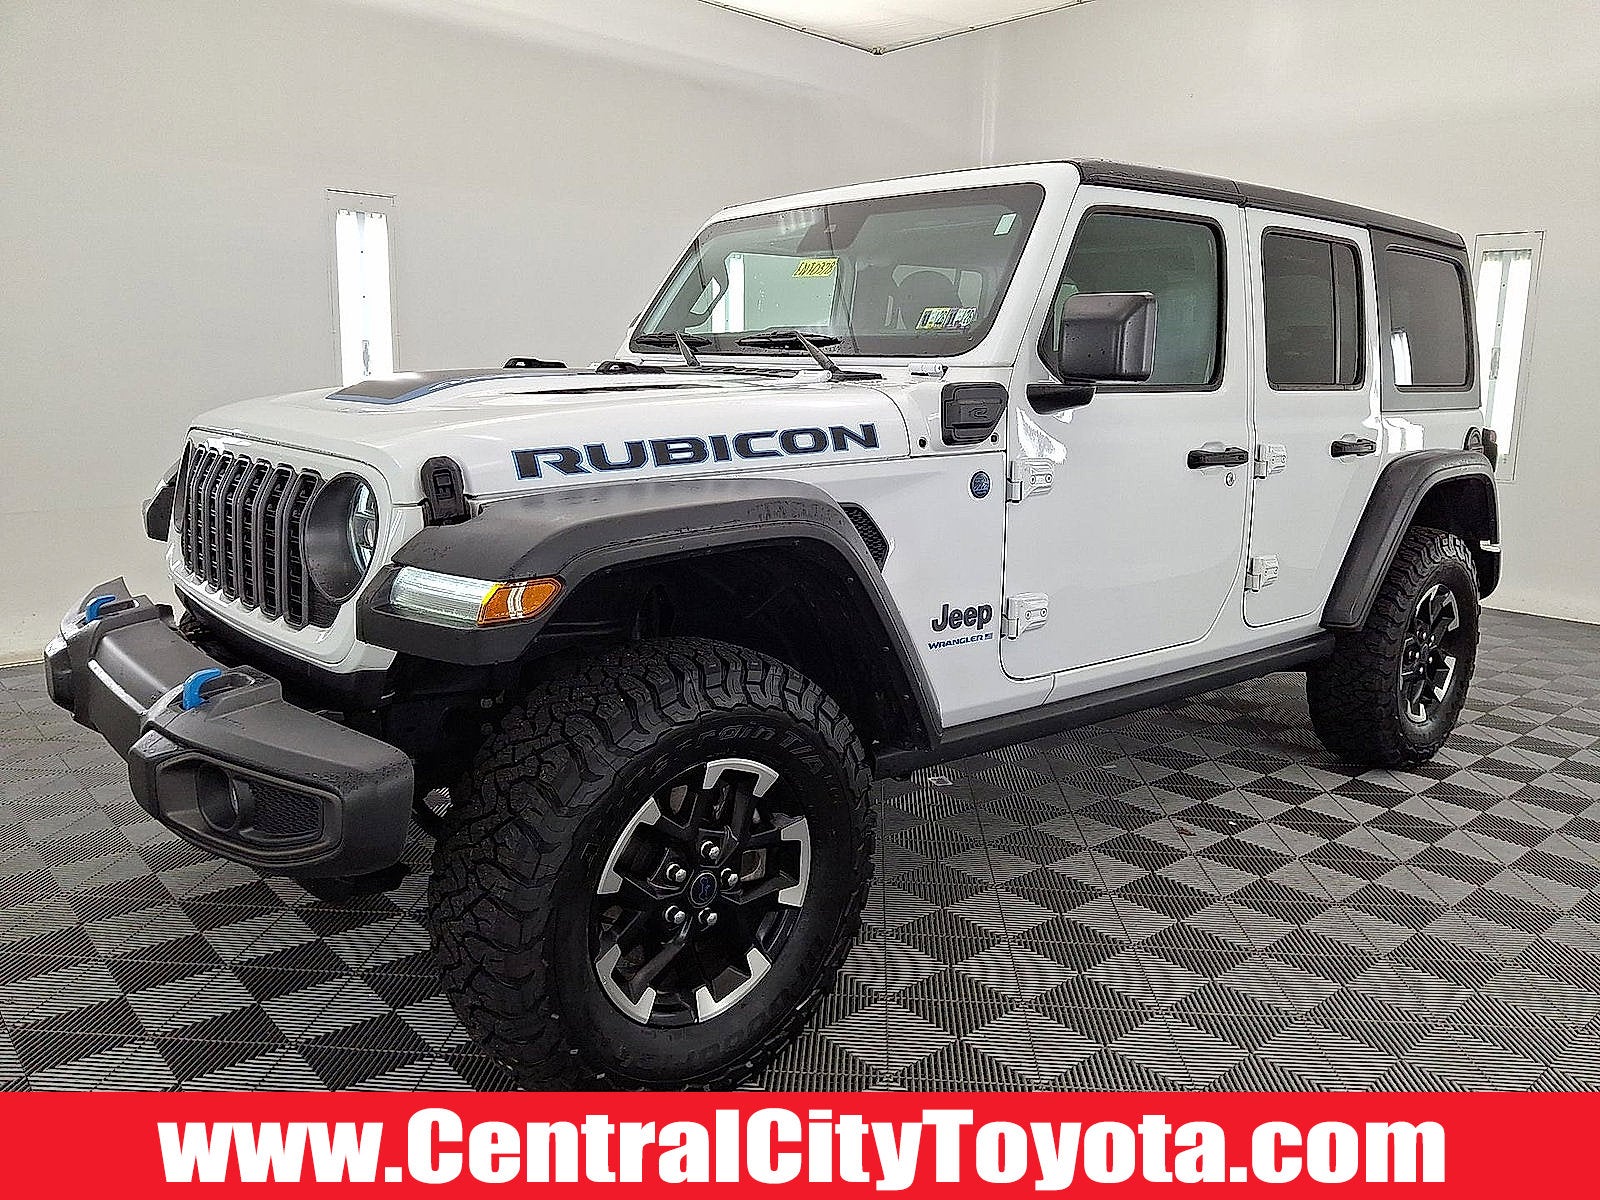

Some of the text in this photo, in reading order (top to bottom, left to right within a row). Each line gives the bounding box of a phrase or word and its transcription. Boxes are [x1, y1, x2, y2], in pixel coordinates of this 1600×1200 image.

[511, 422, 880, 480] RUBICON
[931, 603, 993, 632] Jeep
[927, 634, 984, 650] WRANGLER
